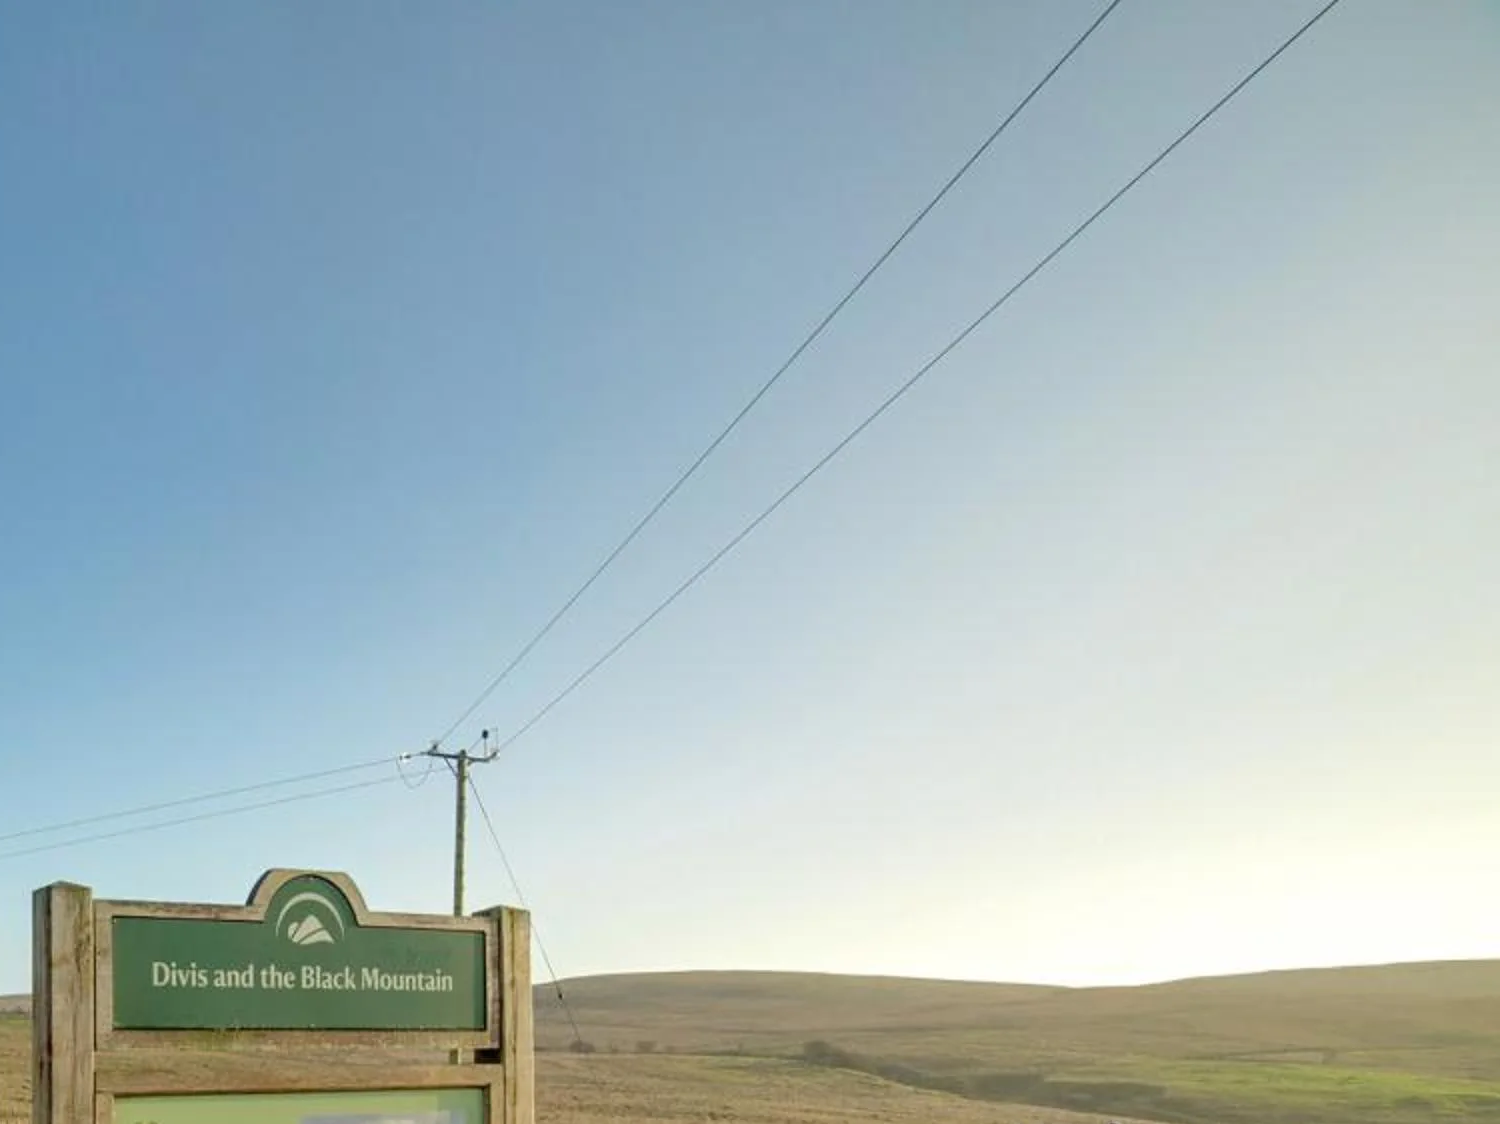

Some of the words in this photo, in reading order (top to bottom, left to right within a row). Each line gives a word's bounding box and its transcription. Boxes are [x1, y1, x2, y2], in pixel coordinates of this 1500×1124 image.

[151, 961, 208, 988] Divis
[213, 964, 254, 989] and
[260, 964, 296, 989] the
[301, 966, 357, 990] Black
[361, 967, 453, 992] Mountain
